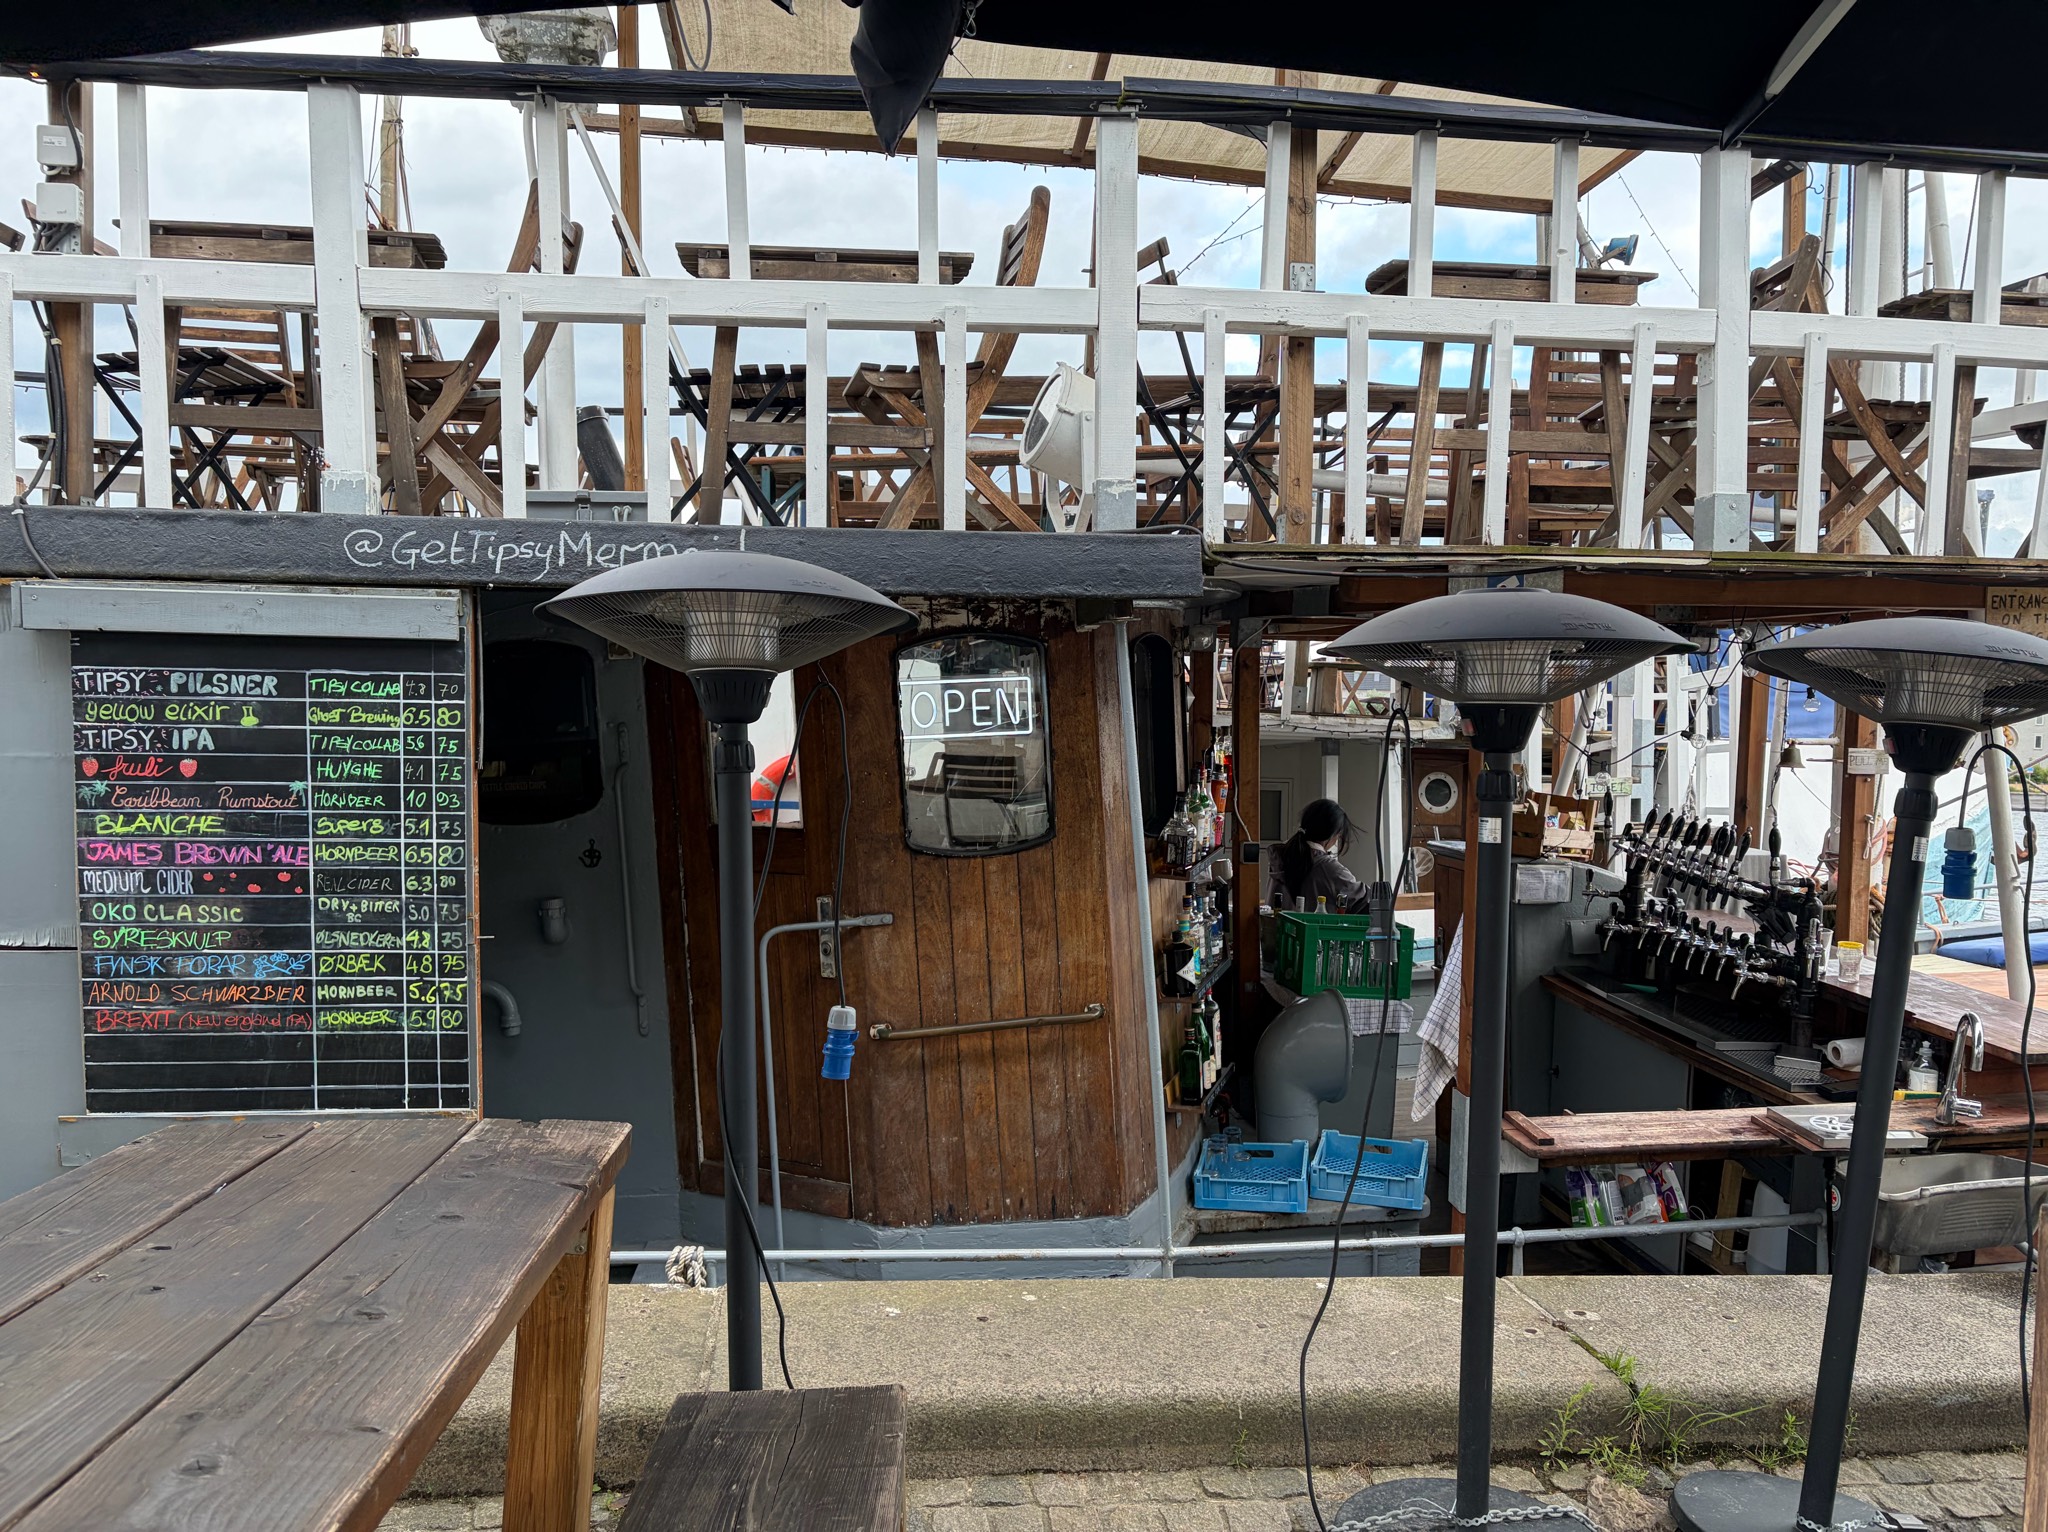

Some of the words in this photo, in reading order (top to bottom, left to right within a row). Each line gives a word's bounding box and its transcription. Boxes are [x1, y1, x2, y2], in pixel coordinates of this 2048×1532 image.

[343, 528, 747, 582] @GetTipsyMerm
[2002, 613, 2022, 625] ON
[78, 671, 146, 693] TIPSY
[169, 671, 278, 696] PILSNER
[350, 680, 401, 697] COLLAB
[405, 680, 426, 696] 4.8
[438, 682, 459, 697] 70
[402, 706, 431, 726] 6.5
[436, 707, 461, 727] 80
[911, 687, 1020, 729] OPEN
[82, 728, 155, 751] TIPSY
[172, 728, 215, 750] IPA
[437, 736, 459, 753] 75
[317, 758, 383, 780] HUYGHE
[404, 762, 424, 781] 4.1
[438, 763, 462, 781] 75
[111, 785, 202, 809] Caribbean
[218, 786, 299, 809] Rumstout
[314, 789, 386, 807] HORNBEER
[406, 789, 427, 808] 10
[436, 791, 461, 808] 93
[95, 813, 226, 836] BLANCHE
[438, 820, 462, 837] 75
[87, 842, 163, 866] JAMES
[175, 842, 263, 865] BROWN
[315, 843, 399, 862] HORNBEER
[404, 845, 433, 864] 6.5
[438, 845, 464, 866] 80
[83, 870, 151, 894] MEDIUM
[156, 869, 194, 894] CIDER
[406, 875, 433, 891] 6.3
[439, 875, 456, 888] 80
[143, 904, 244, 923] CLASSIC
[408, 904, 430, 921] 5.0
[438, 903, 461, 921] 75
[405, 929, 432, 949] 4.8
[441, 931, 463, 949] 75
[94, 954, 166, 978] FYNSK
[319, 954, 387, 975] ØRBÆK
[440, 954, 465, 974] 75
[88, 982, 160, 1005] ARNOLD
[317, 984, 397, 1000] HORNBEER
[409, 982, 437, 1003] 5.6
[439, 982, 467, 1003] 75
[319, 1008, 397, 1025] HORNBEER
[409, 1009, 436, 1030] 5.9
[440, 1009, 463, 1029] 80
